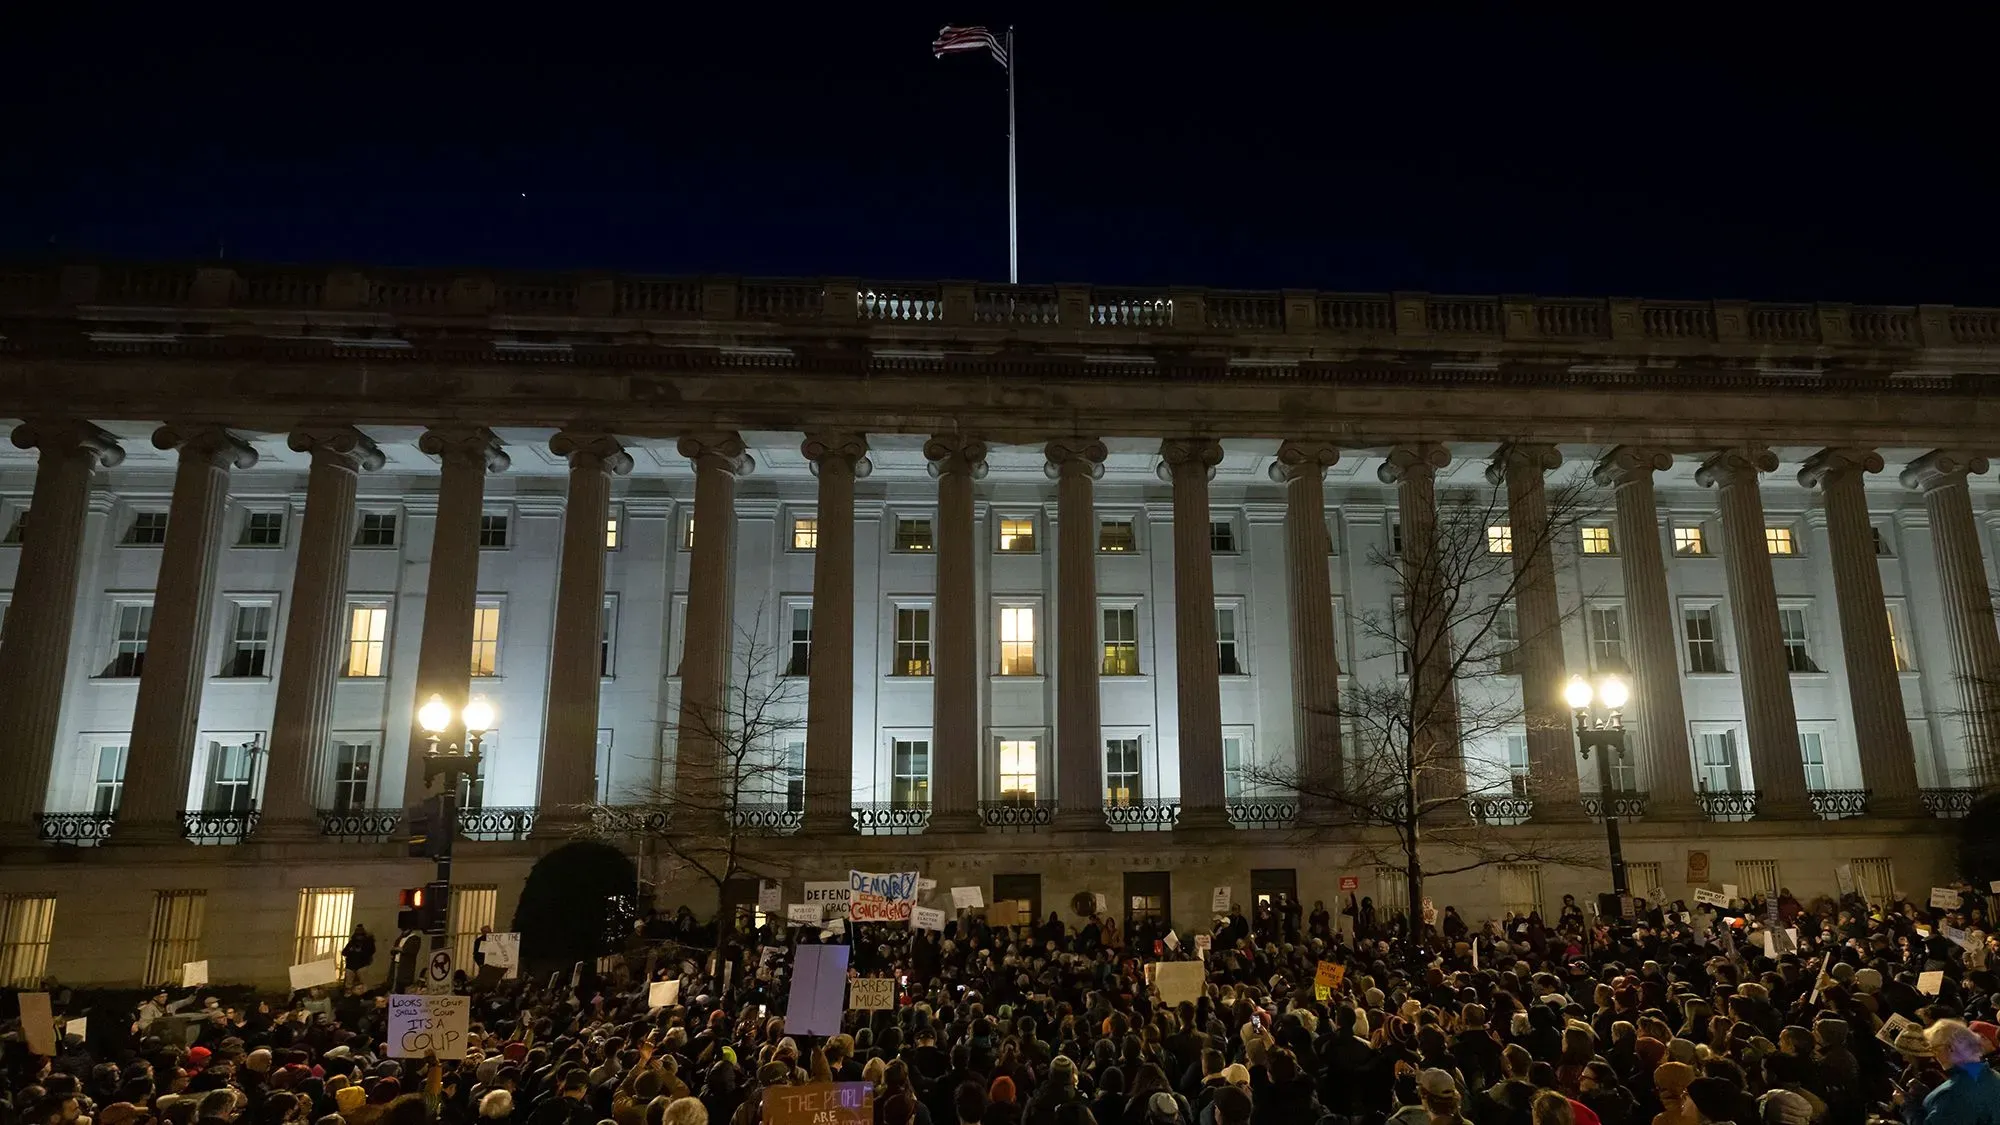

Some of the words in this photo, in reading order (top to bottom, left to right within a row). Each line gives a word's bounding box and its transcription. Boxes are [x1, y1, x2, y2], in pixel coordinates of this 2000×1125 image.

[807, 889, 851, 901] DEFEND
[852, 980, 895, 993] ARREST
[392, 998, 422, 1008] LOOKS
[855, 994, 891, 1007] MUSK
[407, 1018, 433, 1031] IT'S
[436, 1019, 445, 1029] A
[401, 1030, 459, 1053] COUP
[781, 1092, 820, 1114] THE
[823, 1085, 874, 1110] PEOPLE
[813, 1110, 836, 1124] ARE
